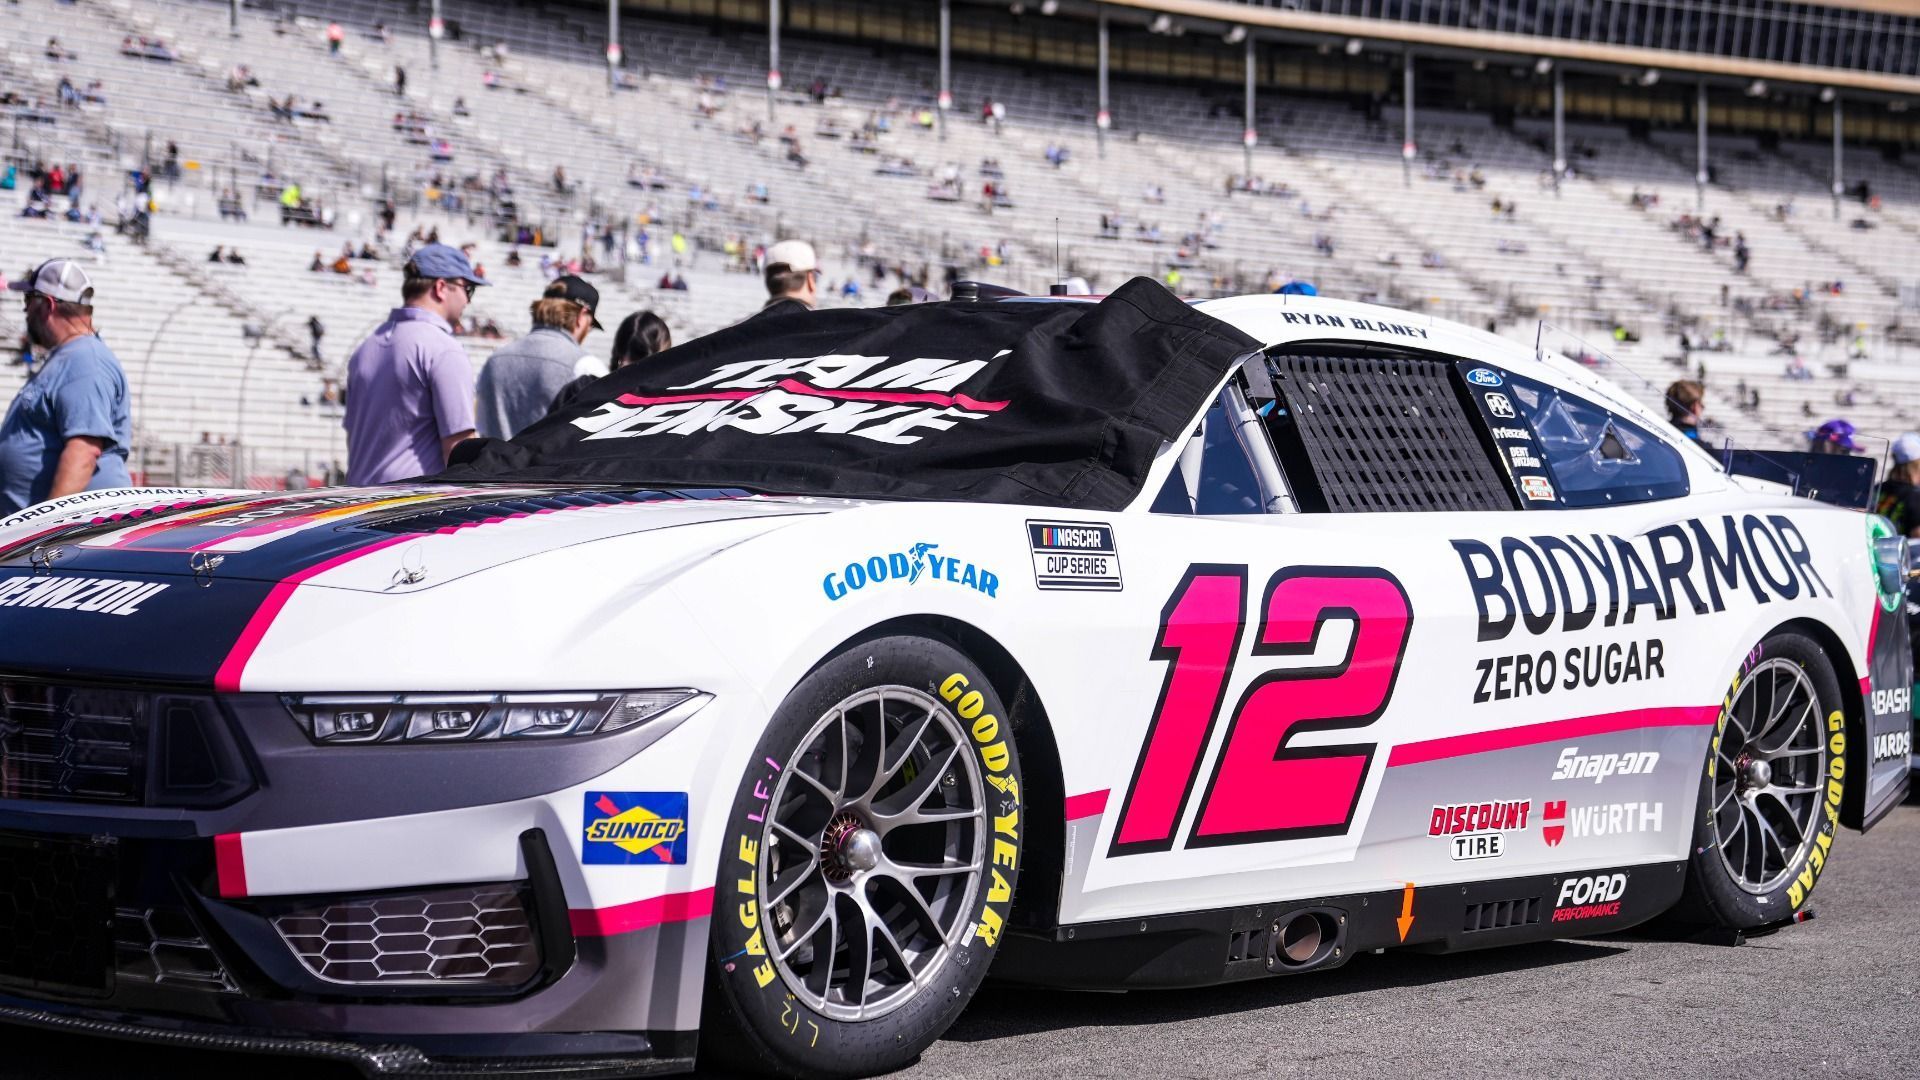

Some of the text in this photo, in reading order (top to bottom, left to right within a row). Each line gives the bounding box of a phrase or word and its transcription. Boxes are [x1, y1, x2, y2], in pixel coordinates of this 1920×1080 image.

[1281, 312, 1428, 339] RYAN BLANEY
[1474, 371, 1497, 385] Ford
[0, 489, 209, 528] ORD PERFORMANCE
[1057, 527, 1102, 548] NASCAR
[822, 548, 1000, 601] GOODYEAR
[1047, 556, 1107, 575] CUP SERIES
[1449, 514, 1834, 643] BODYARMOR
[1473, 638, 1665, 703] ZERO SUGAR
[1106, 562, 1415, 858] 12
[1552, 747, 1660, 784] Snap-on
[590, 822, 681, 839] SUNOCO
[1428, 800, 1531, 837] DISCOUNT
[1455, 836, 1500, 857] TIRE
[1556, 873, 1628, 908] FORD
[738, 834, 776, 989] EAGLE
[1551, 902, 1621, 923] PERFORMANCE
